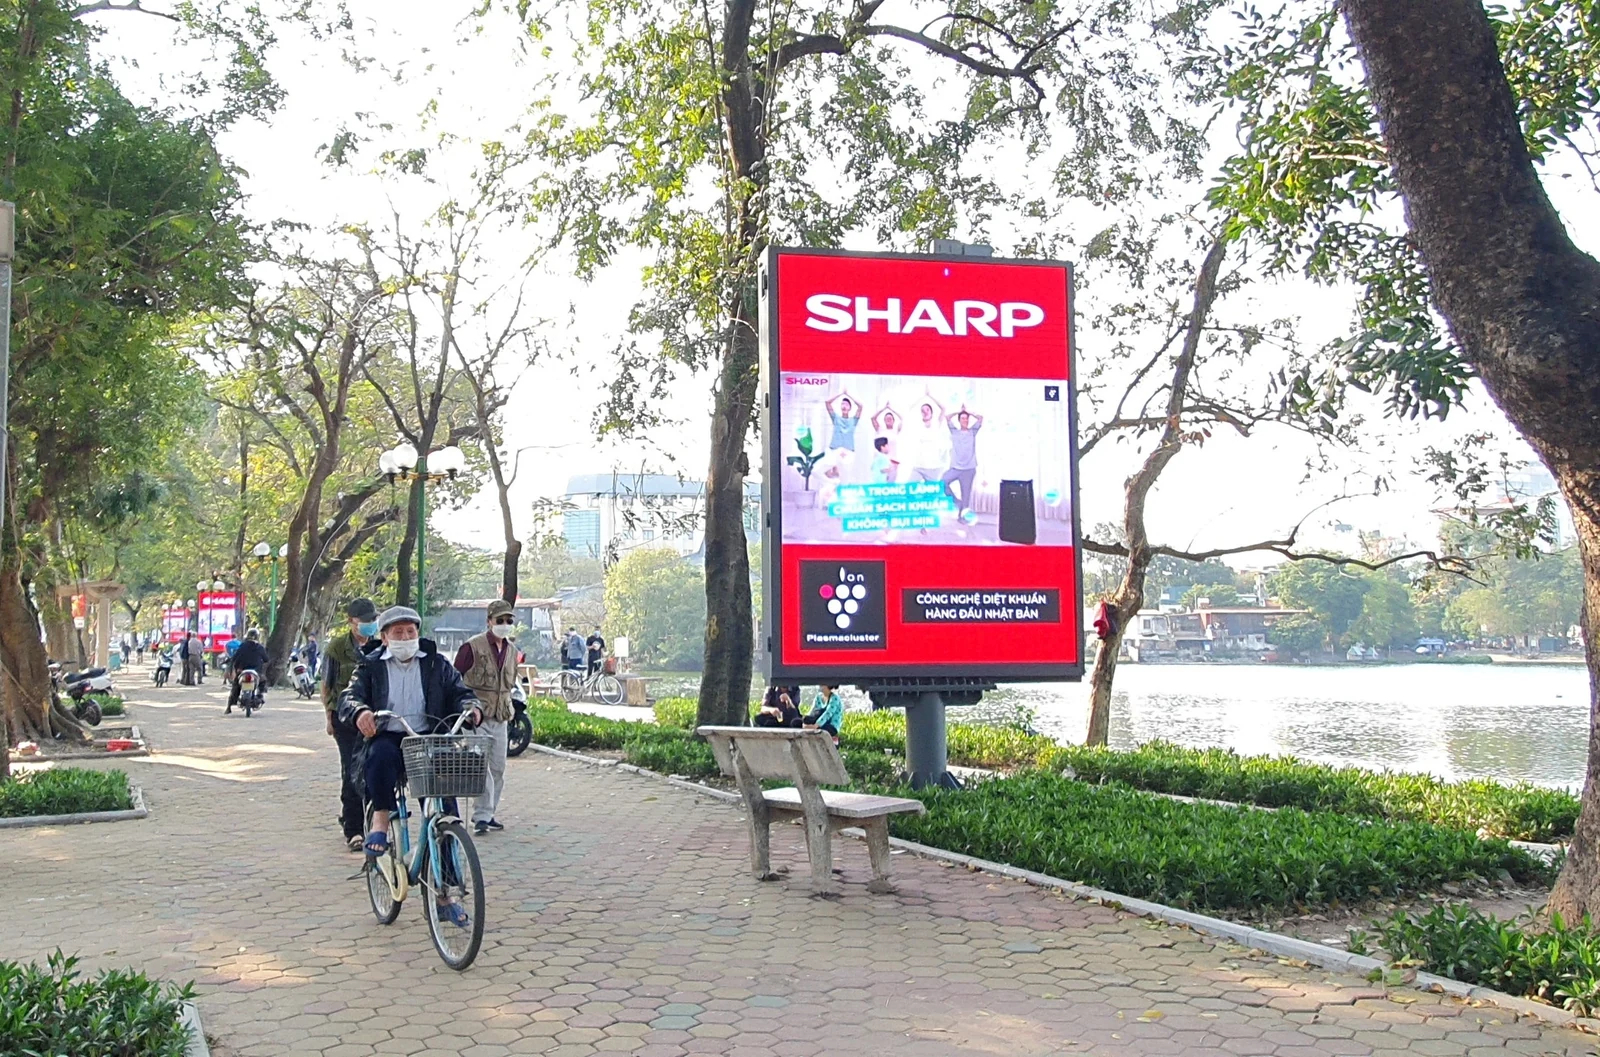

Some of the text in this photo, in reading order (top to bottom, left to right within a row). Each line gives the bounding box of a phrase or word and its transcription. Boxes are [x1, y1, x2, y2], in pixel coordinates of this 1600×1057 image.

[805, 293, 1044, 338] SHARP
[785, 377, 829, 386] SHARP
[868, 485, 906, 497] TRONG
[916, 592, 948, 605] CÔNG
[950, 592, 981, 606] NGHỆ
[982, 592, 1007, 606] DIỆT
[925, 606, 957, 619] HÀNG
[984, 606, 1014, 621] NHẬT
[1015, 606, 1039, 619] BẢN
[806, 633, 880, 643] Plasmacluster
